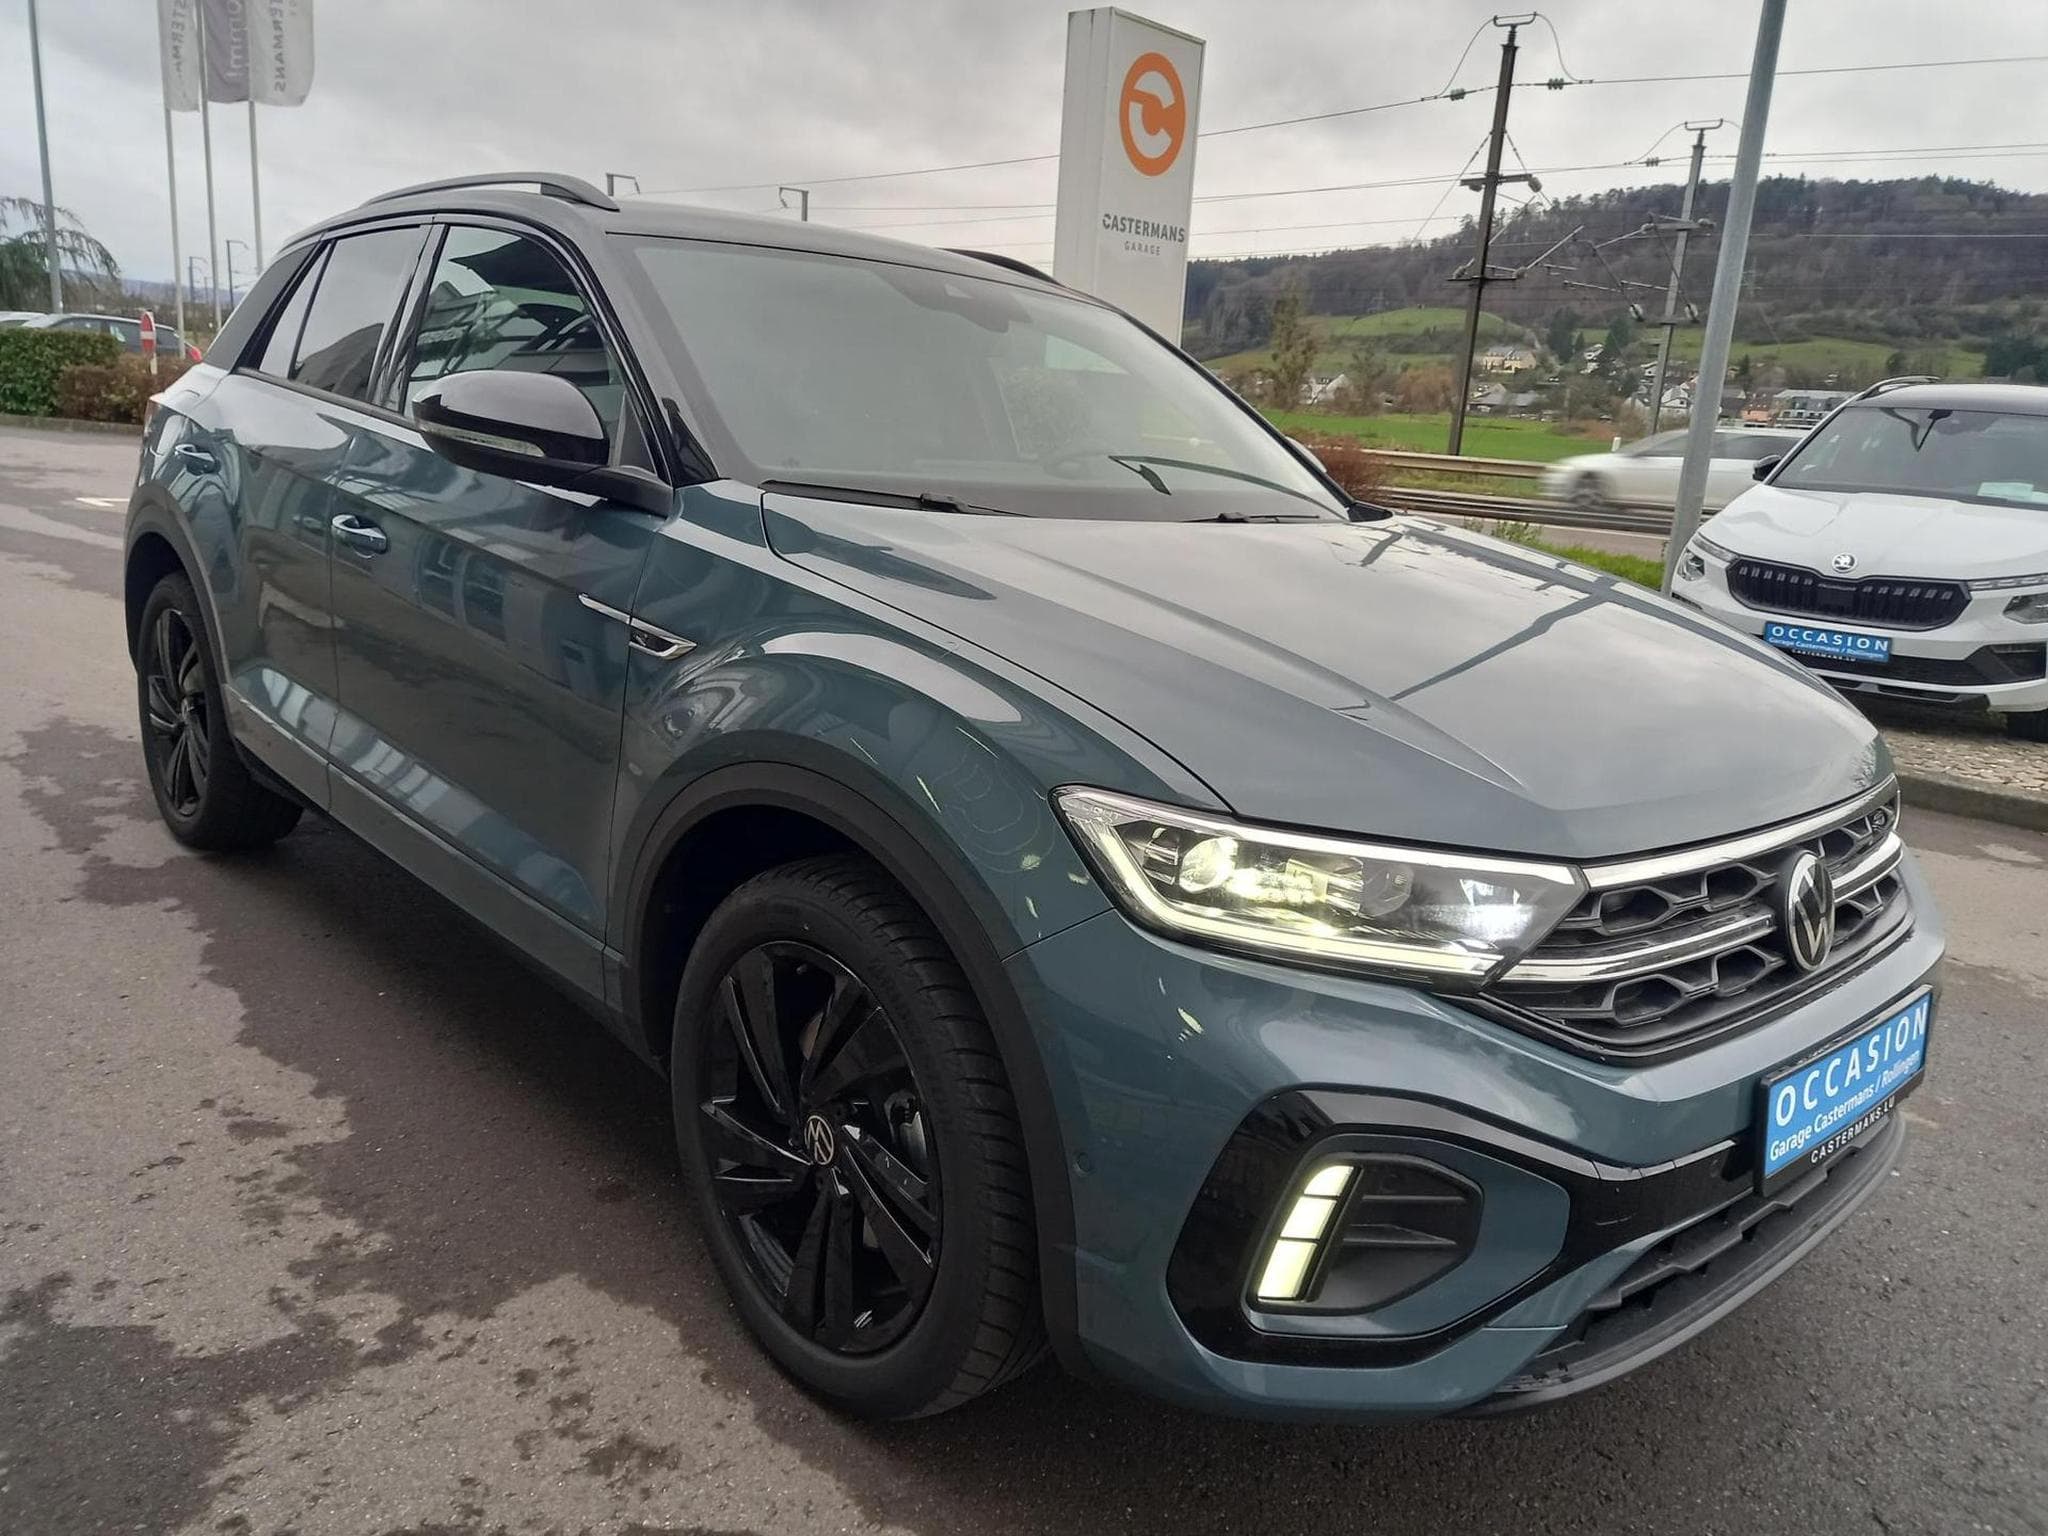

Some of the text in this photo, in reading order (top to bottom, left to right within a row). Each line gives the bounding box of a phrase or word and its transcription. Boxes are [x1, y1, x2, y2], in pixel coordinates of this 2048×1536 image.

[1102, 213, 1185, 243] CASTERMANS
[1124, 240, 1161, 256] GARAGE
[1771, 626, 1889, 652] OCCASION
[1775, 1001, 1929, 1127] OCCASION
[1770, 1126, 1817, 1161] Garage
[1814, 1084, 1875, 1133] Castermans
[1810, 1095, 1895, 1164] CASTERMANS.LU
